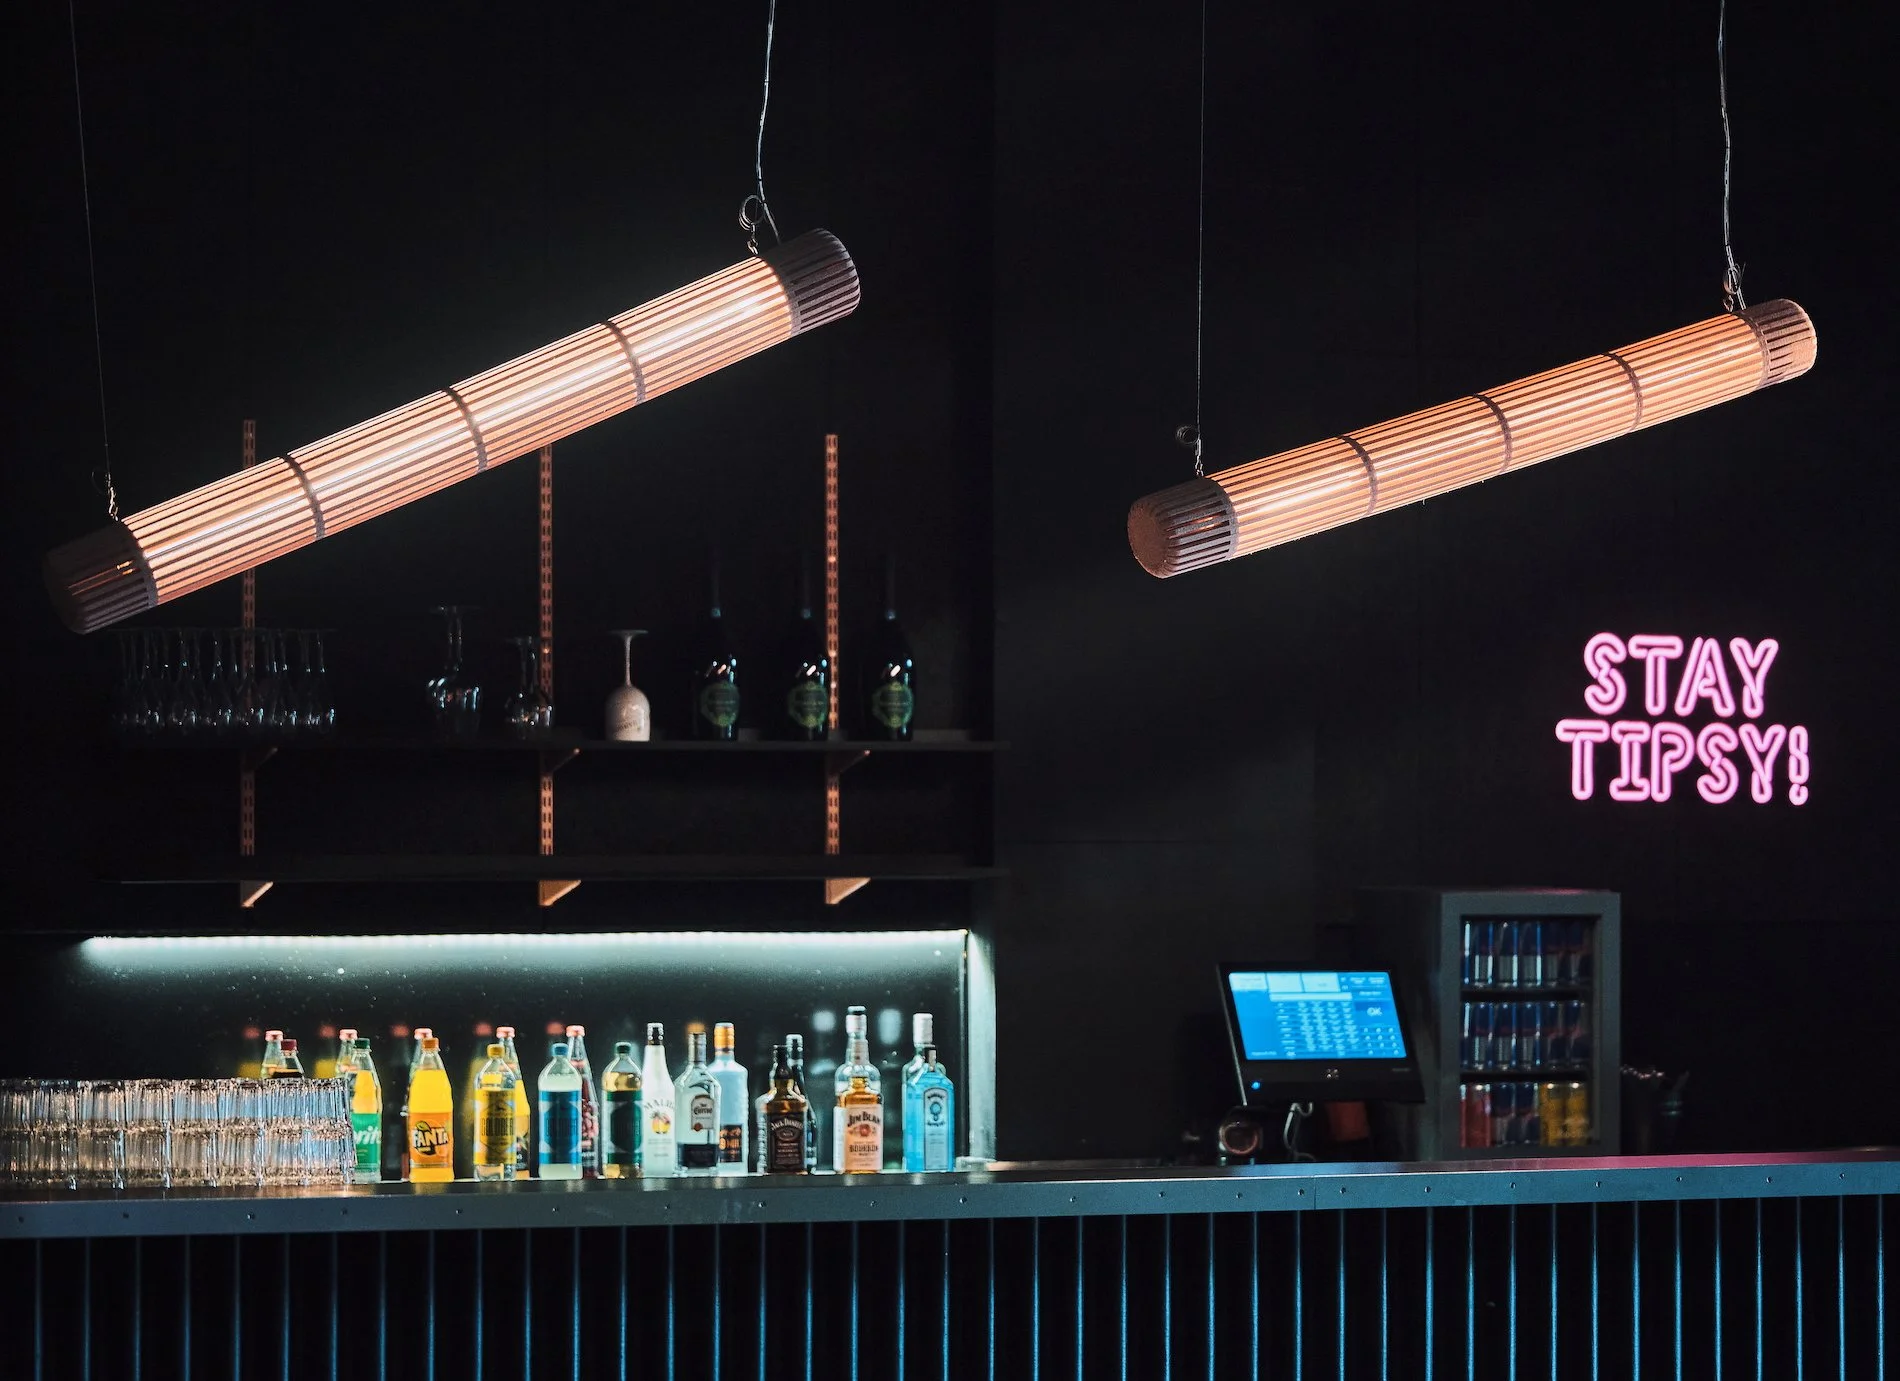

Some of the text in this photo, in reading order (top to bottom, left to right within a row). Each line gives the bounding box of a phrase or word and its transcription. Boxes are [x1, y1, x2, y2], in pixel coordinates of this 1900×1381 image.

[1584, 632, 1779, 718] STAY
[1555, 719, 1810, 806] TIPSY!
[412, 1126, 449, 1148] FANTA
